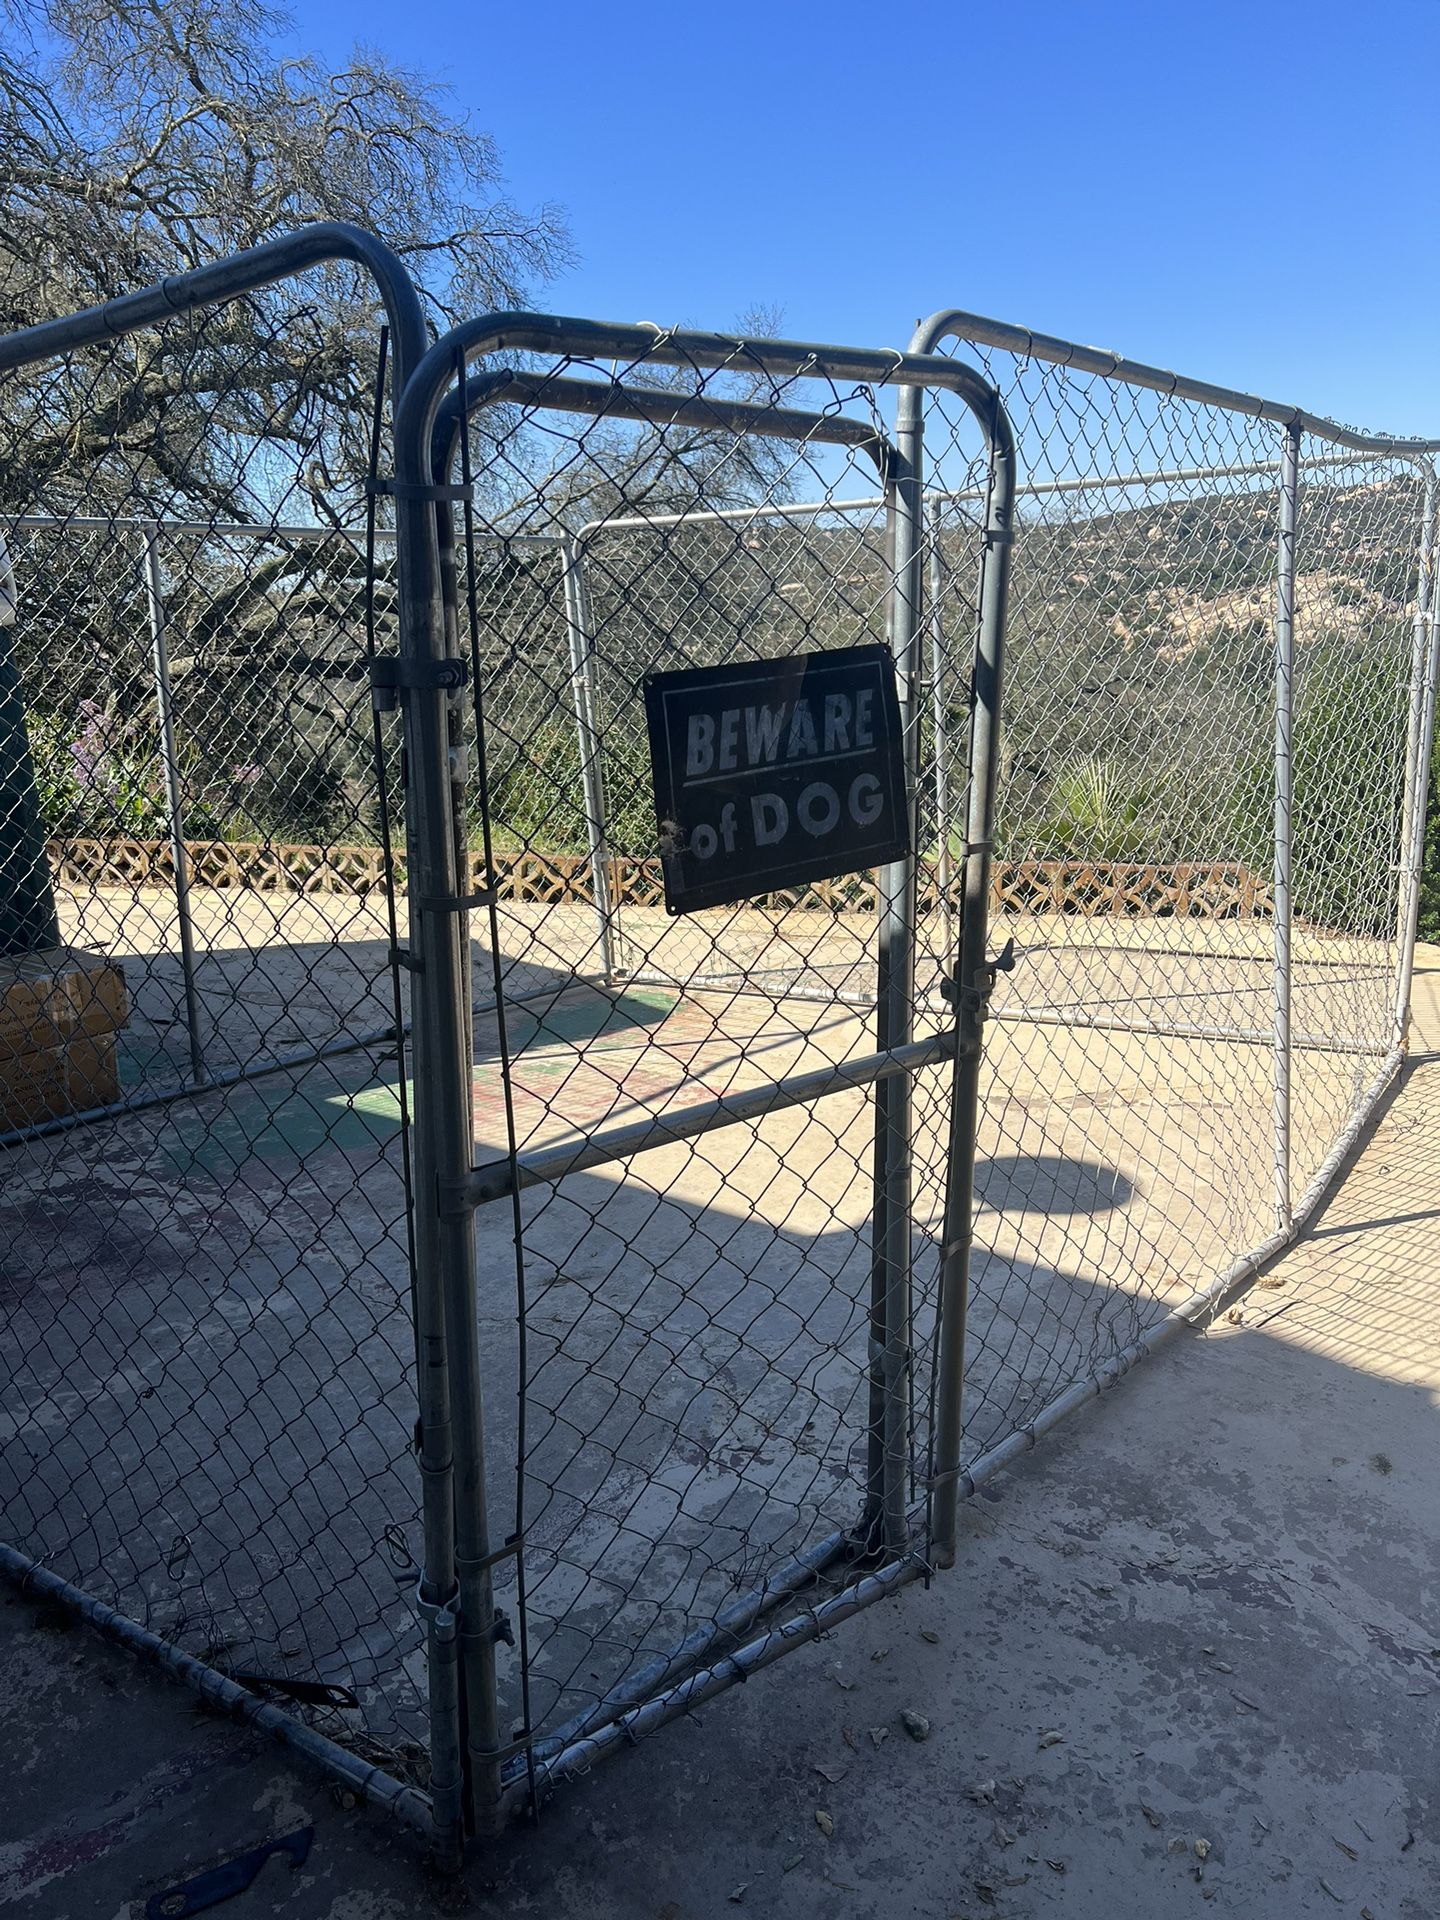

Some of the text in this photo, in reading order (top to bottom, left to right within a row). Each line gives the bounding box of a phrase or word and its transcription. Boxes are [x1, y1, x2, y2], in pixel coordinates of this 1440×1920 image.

[686, 689, 874, 777] BEWARE
[690, 773, 884, 859] of DOG
